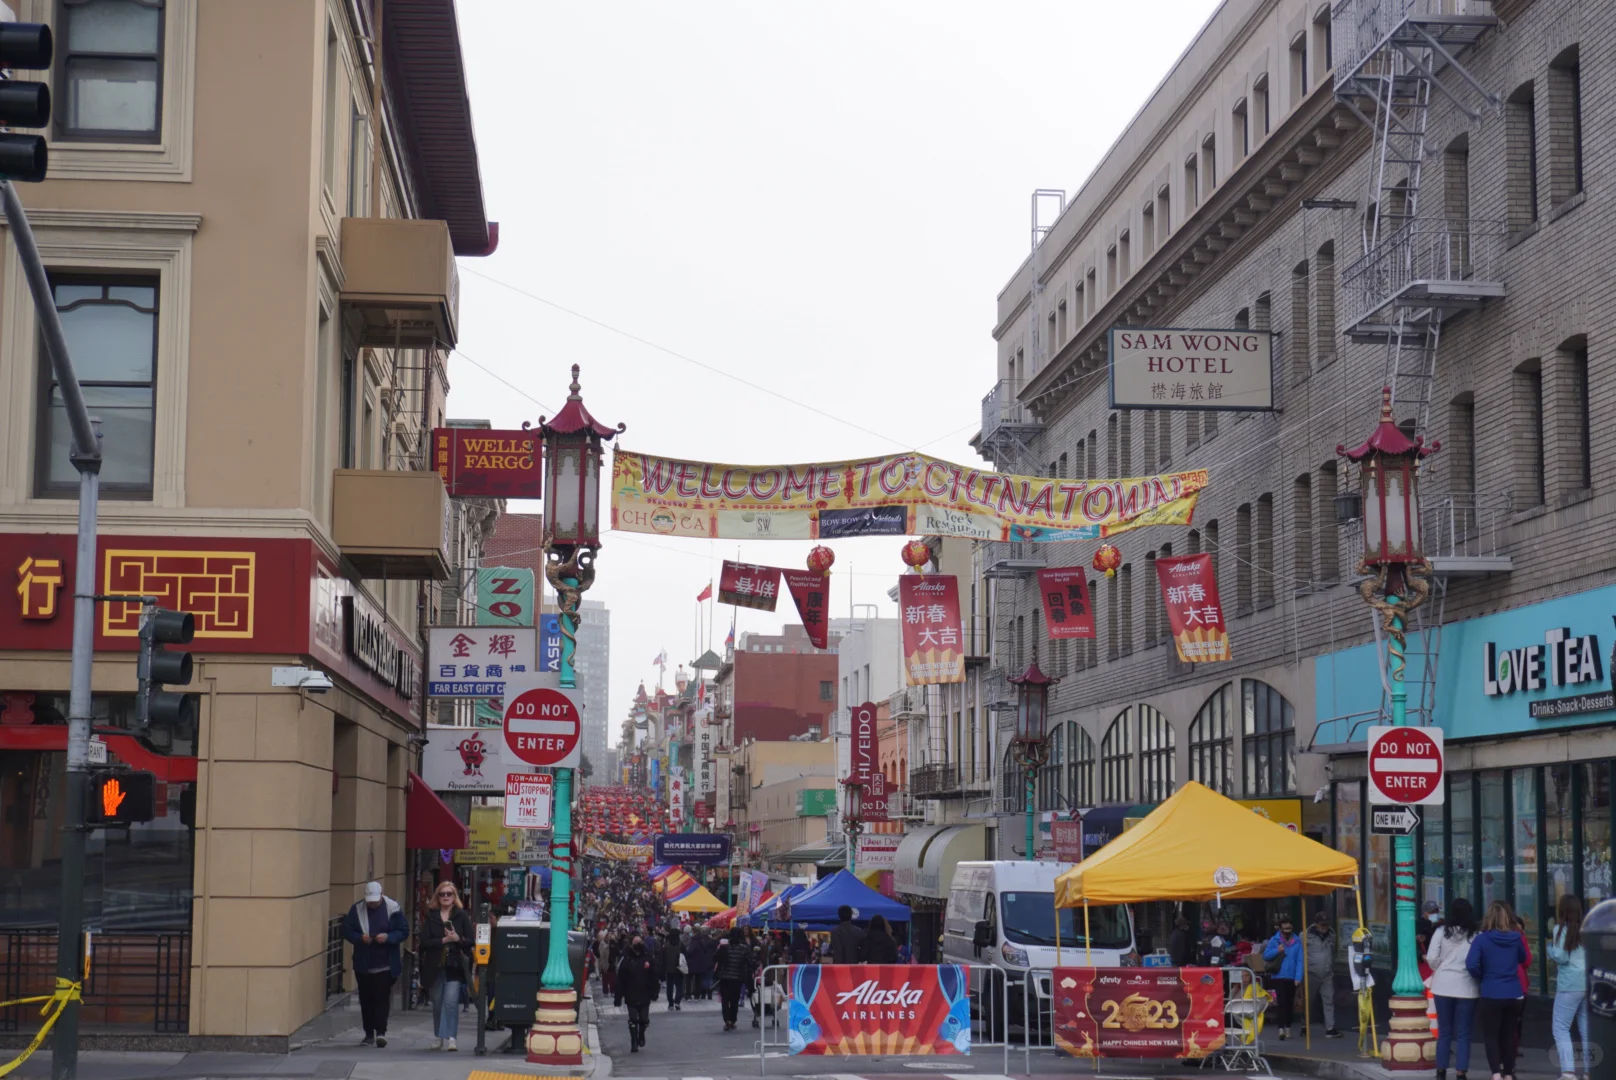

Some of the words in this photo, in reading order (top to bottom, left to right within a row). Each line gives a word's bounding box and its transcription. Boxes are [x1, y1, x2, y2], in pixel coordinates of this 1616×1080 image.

[1121, 333, 1172, 350] SAM
[1180, 334, 1259, 352] WONG
[1148, 356, 1233, 374] HOTEL
[463, 438, 534, 453] WELLS
[464, 454, 534, 469] FARGO
[640, 455, 840, 500] WELCOME
[855, 455, 910, 498] TO
[924, 462, 1183, 520] CHINATOWN
[944, 509, 973, 523] Yee's
[926, 516, 991, 539] Restaurant
[1168, 562, 1201, 573] Alaska
[18, 556, 62, 615] 行
[912, 581, 946, 591] Alaska
[1167, 583, 1206, 604] 新春
[906, 604, 946, 624] 新春
[1183, 605, 1219, 625] 大吉
[918, 626, 958, 646] 大吉
[448, 632, 516, 659] 金輝
[547, 636, 560, 670] ASE
[1484, 642, 1542, 696] LOVE
[1545, 627, 1600, 686] TEA
[434, 683, 451, 693] FAR
[452, 683, 474, 693] EAST
[475, 684, 495, 693] GIFT
[516, 703, 535, 715] DO
[541, 704, 569, 717] NOT
[517, 737, 565, 751] ENTER
[1380, 743, 1397, 754] DO
[1406, 743, 1431, 755] NOT
[89, 745, 103, 759] RANT
[510, 774, 549, 782] TOW-AWAY
[1385, 776, 1427, 788] ENTER
[507, 782, 519, 794] NO
[520, 784, 549, 796] STOPPING
[519, 797, 537, 806] ANY
[862, 802, 873, 810] ee
[518, 807, 537, 817] TIME
[1375, 813, 1389, 826] ONE
[1391, 813, 1405, 826] WAY
[1100, 976, 1121, 984] xfinity
[836, 980, 924, 1007] Alaska
[842, 1010, 916, 1019] AIRLINES
